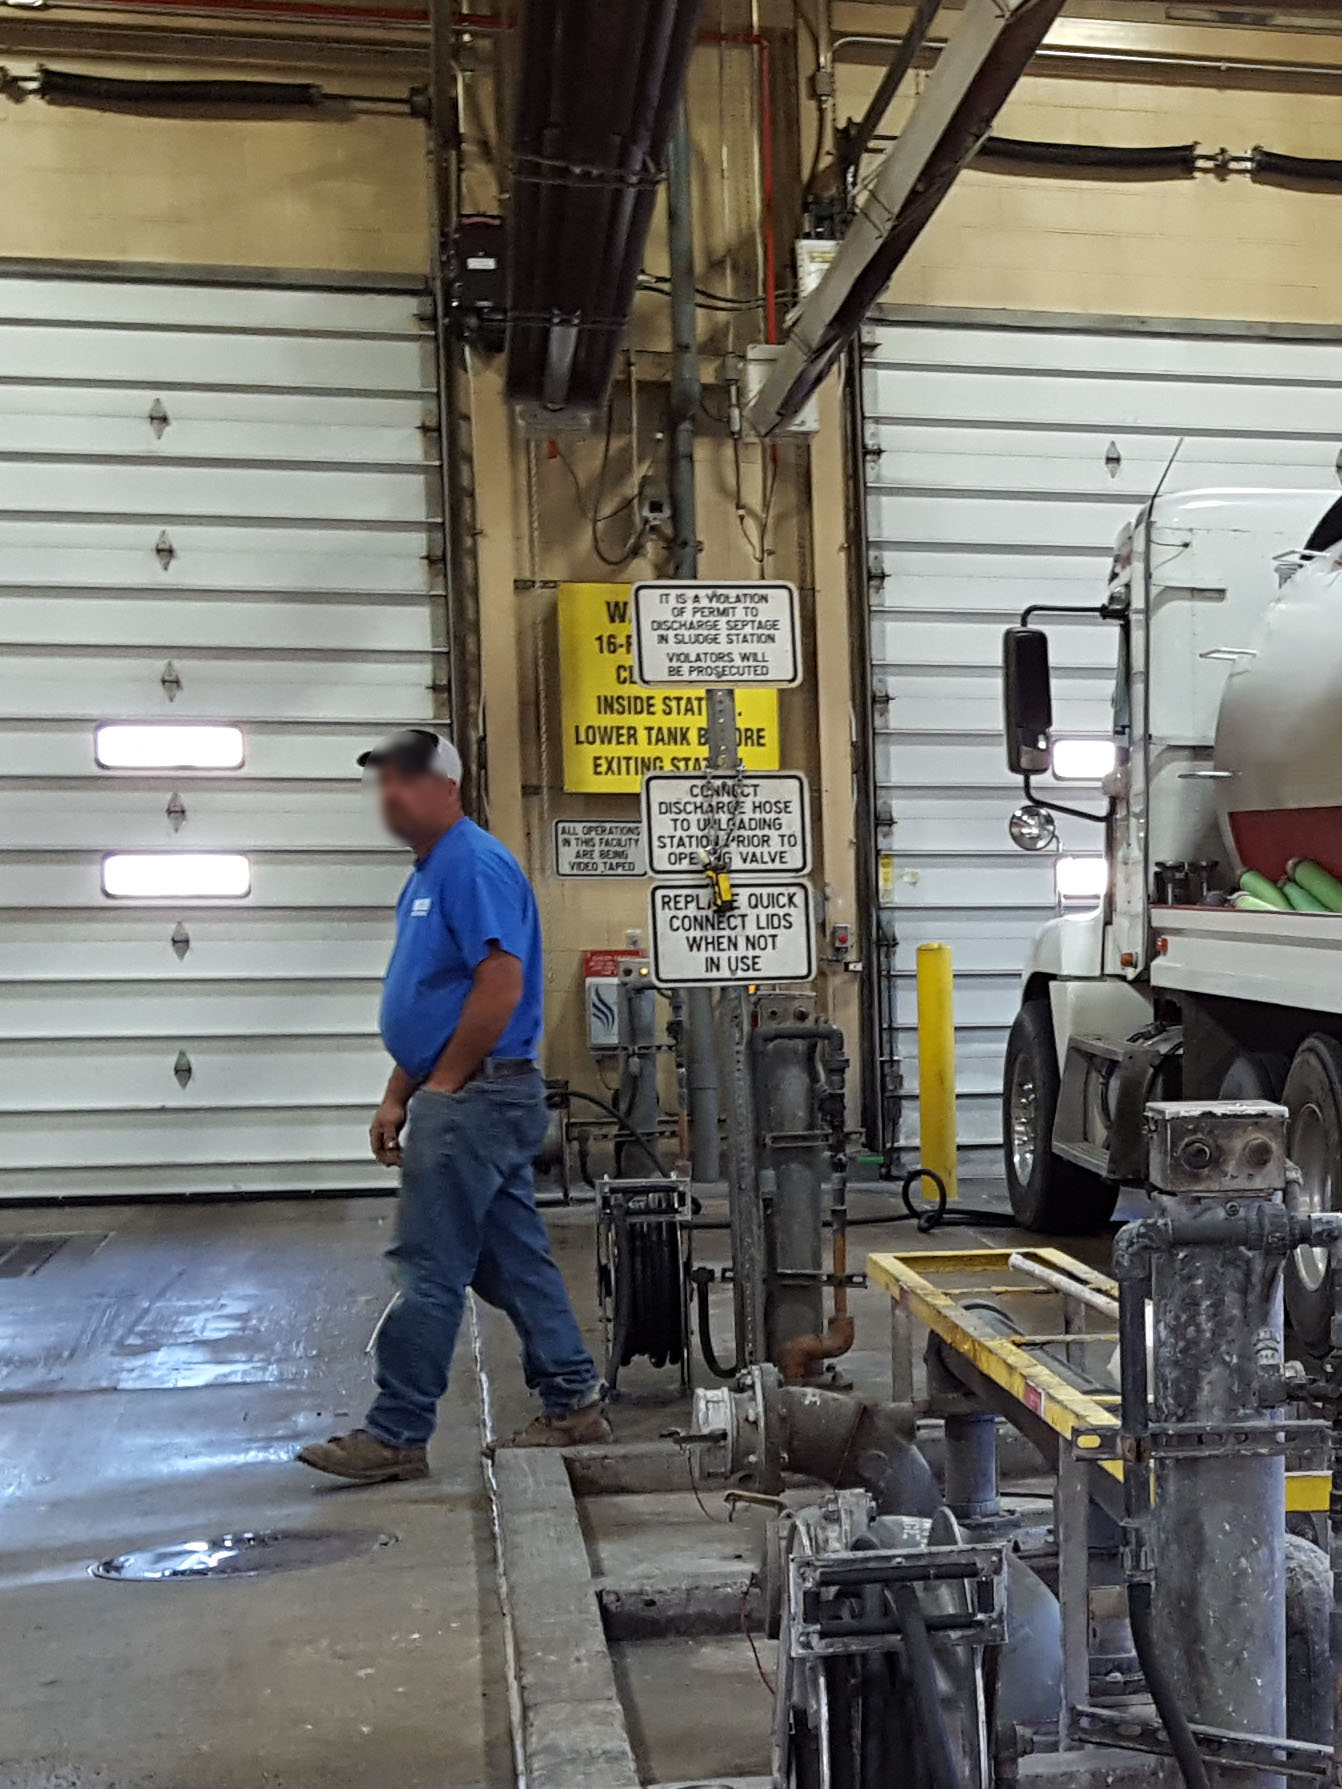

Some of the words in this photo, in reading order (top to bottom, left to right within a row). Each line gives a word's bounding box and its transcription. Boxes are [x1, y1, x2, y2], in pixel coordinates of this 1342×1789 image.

[659, 593, 671, 605] IT
[676, 593, 688, 605] IS
[692, 593, 701, 605] A
[706, 592, 769, 605] VIOLATION
[671, 606, 686, 618] OF
[692, 606, 737, 618] PERMIT
[743, 606, 759, 618] TO
[651, 620, 721, 631] DISCHARGE
[726, 620, 781, 631] SEPTAGE
[657, 633, 669, 645] IN
[674, 633, 721, 645] SLUDGE
[726, 633, 776, 645] STATION
[667, 652, 734, 663] VIOLATORS
[739, 652, 769, 663] WILL
[668, 665, 684, 677] BE
[688, 665, 769, 677] PROSECUTED
[597, 695, 655, 716] INSIDE
[575, 725, 638, 746] LOWER
[645, 726, 691, 746] TANK
[593, 756, 664, 776] EXITING
[752, 800, 793, 814] HOSE
[561, 826, 579, 835] ALL
[582, 826, 641, 836] OPERATIONS
[670, 818, 690, 832] TO
[574, 838, 595, 847] THIS
[599, 838, 639, 847] FACILITY
[778, 834, 797, 848] TO
[575, 850, 595, 859] ARE
[600, 850, 628, 860] BEING
[739, 851, 788, 865] VALVE
[569, 862, 598, 871] VIDEO
[602, 862, 636, 872] TAPED
[748, 892, 799, 910] QUICK
[669, 913, 748, 932] CONNECT
[756, 913, 793, 930] LIDS
[686, 935, 738, 952] WHEN
[745, 934, 778, 951] NOT
[704, 956, 720, 973] IN
[728, 955, 762, 972] USE
